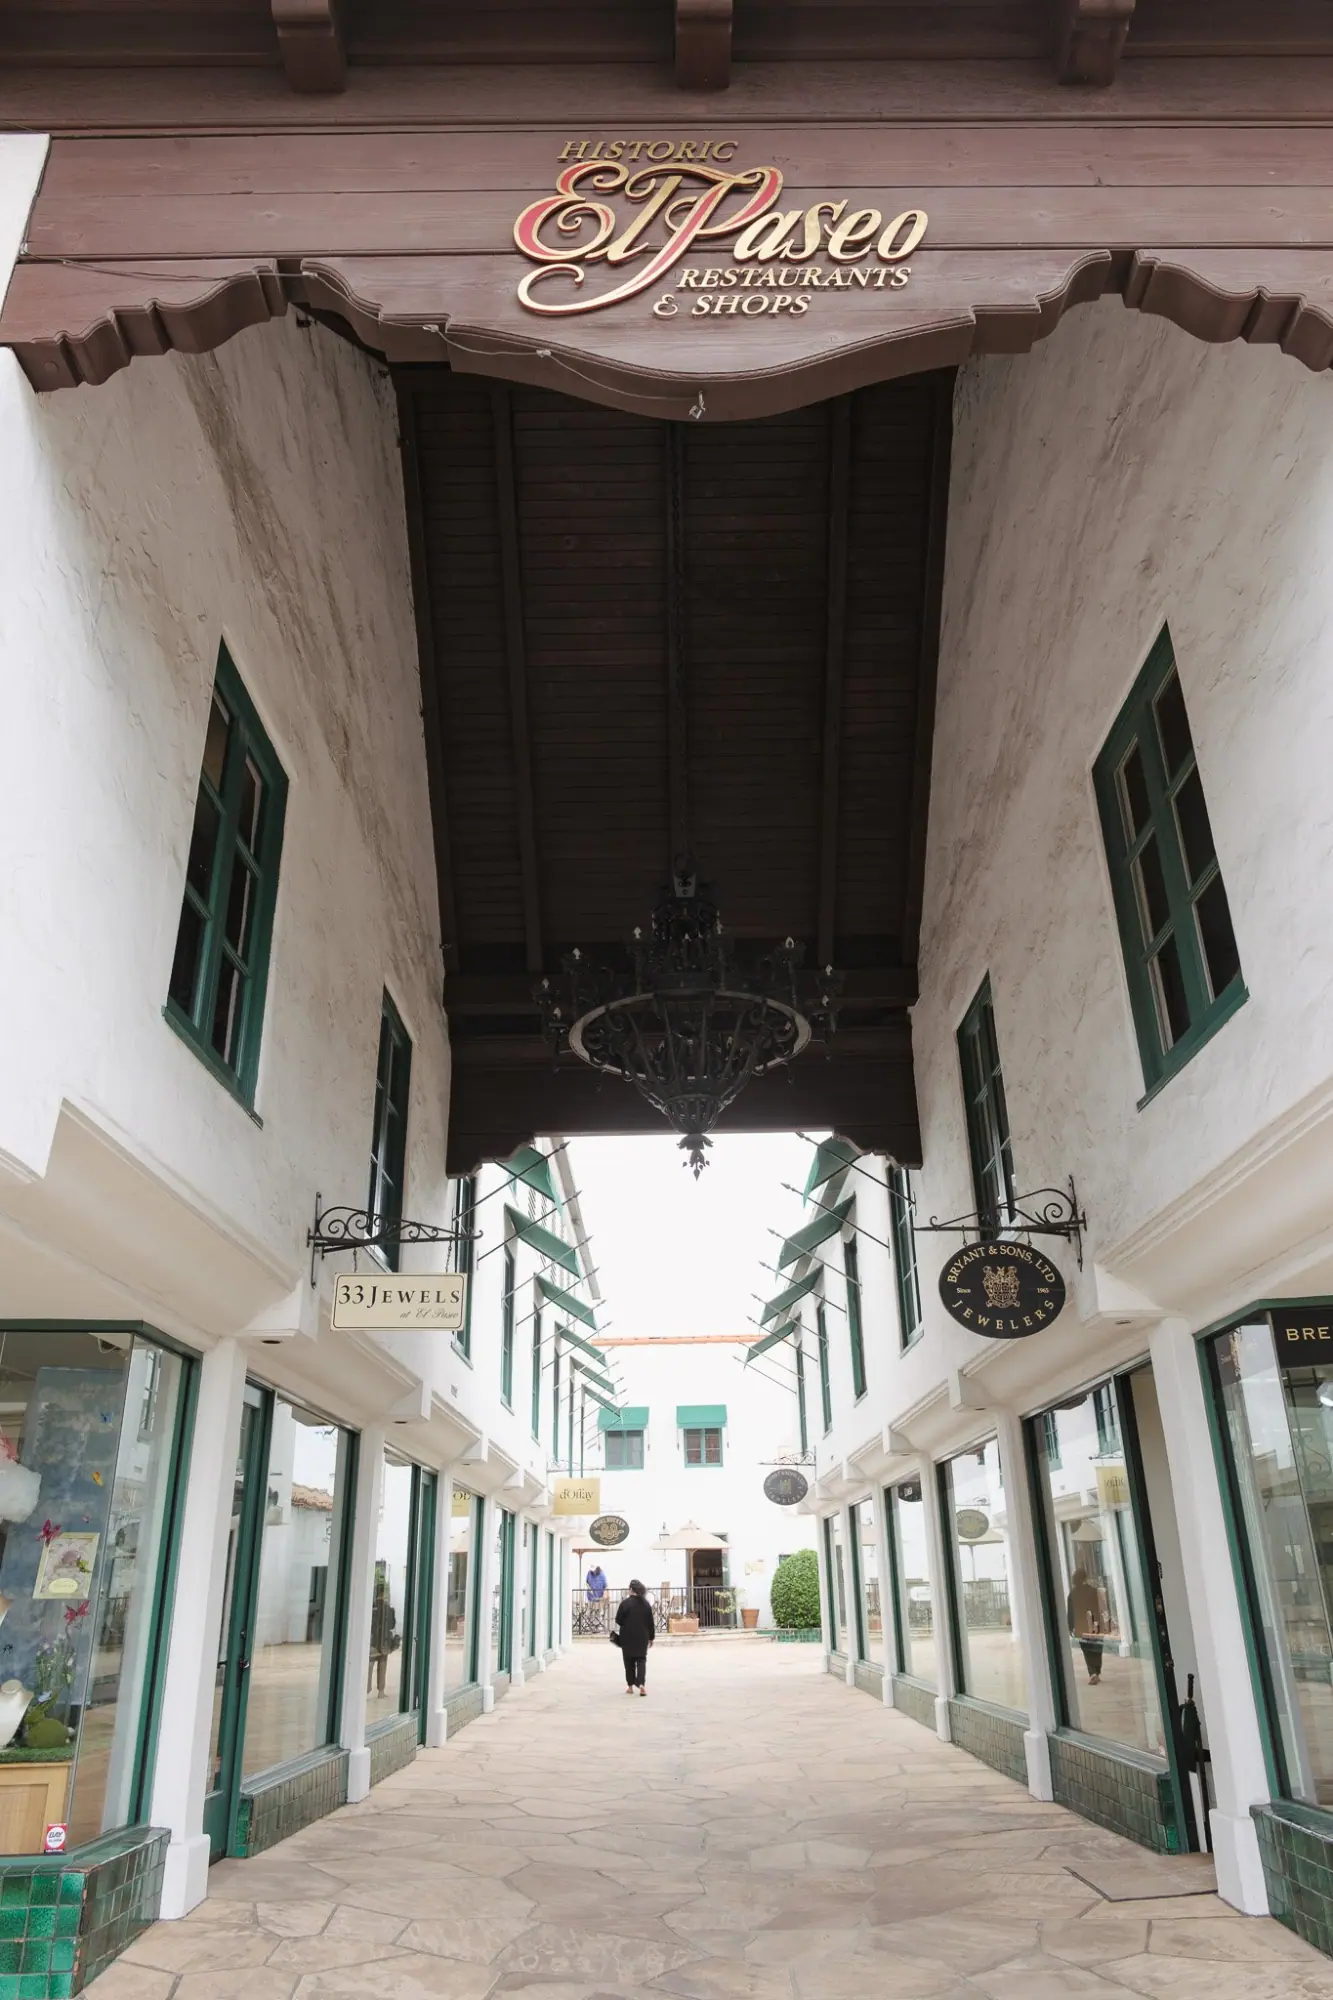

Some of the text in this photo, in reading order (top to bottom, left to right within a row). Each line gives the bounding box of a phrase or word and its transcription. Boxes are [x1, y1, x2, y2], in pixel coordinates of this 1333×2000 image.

[557, 140, 739, 162] HISTORIC
[513, 160, 684, 264] El
[676, 266, 911, 289] RESTAURANTS
[653, 293, 812, 317] & SHOPS
[947, 1245, 1056, 1283] BRYANT & SONS, LTD
[952, 1300, 1055, 1330] JEWELERS
[1285, 1326, 1333, 1341] BRE
